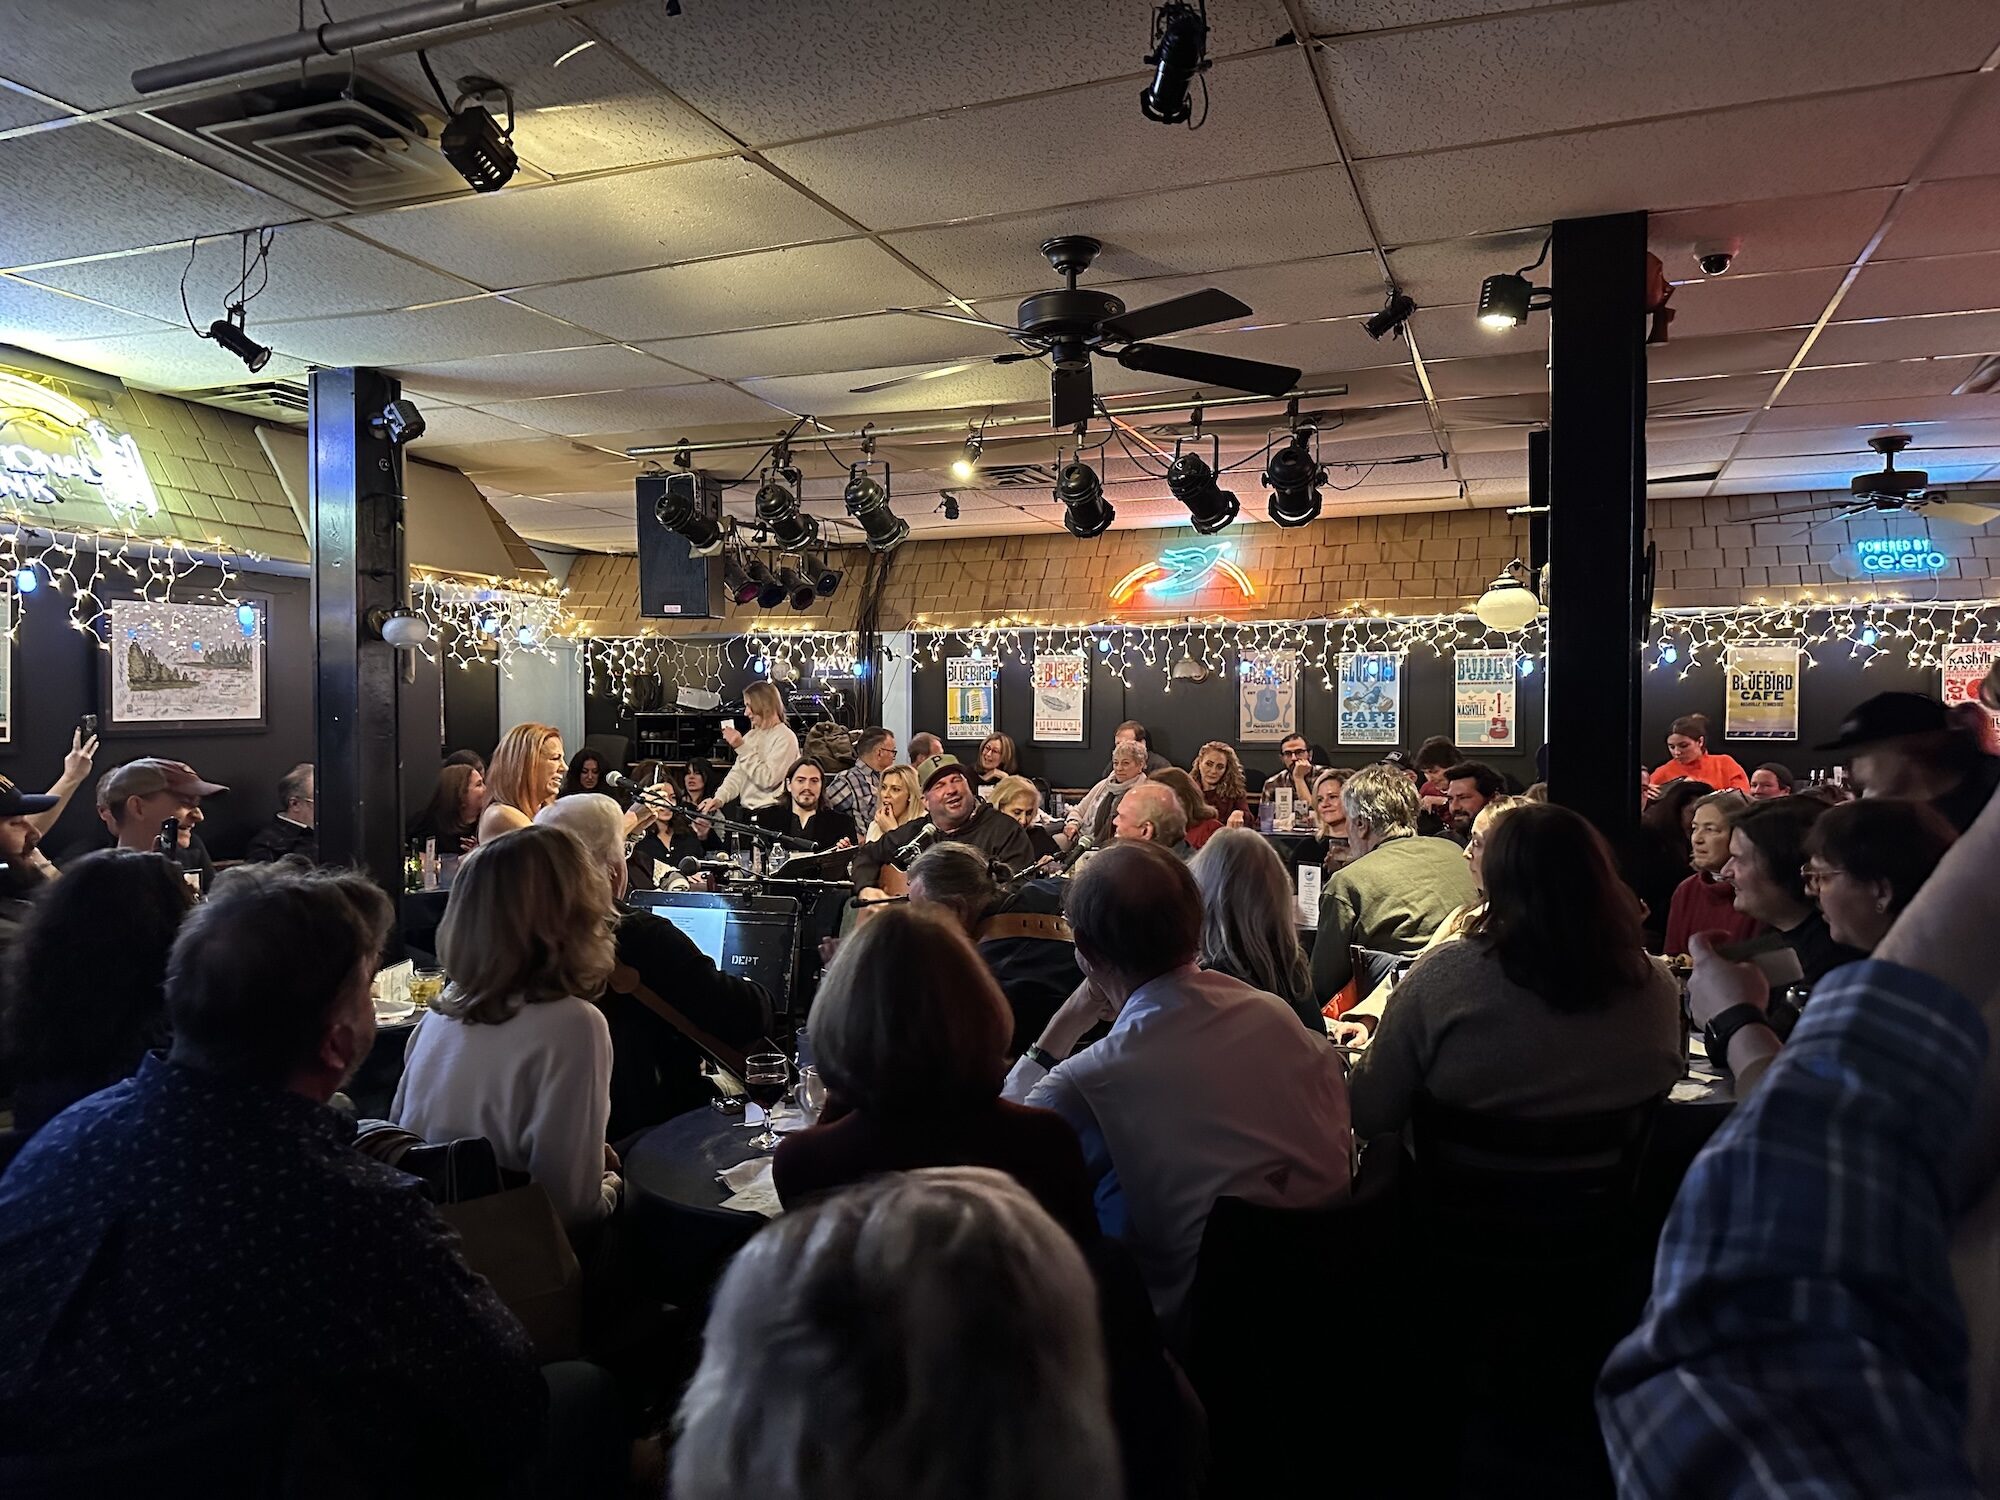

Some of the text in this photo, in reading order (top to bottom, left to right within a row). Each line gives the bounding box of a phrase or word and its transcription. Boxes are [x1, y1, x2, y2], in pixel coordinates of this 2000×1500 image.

[1857, 539, 1931, 555] POWERED BY
[1468, 672, 1504, 680] CAFE
[1733, 674, 1793, 690] BLUEBIRD
[1741, 690, 1784, 700] CAFE
[1457, 704, 1486, 715] NASHVILLE
[1341, 712, 1396, 722] CAFE
[931, 755, 942, 768] P
[731, 955, 759, 965] DEPT
